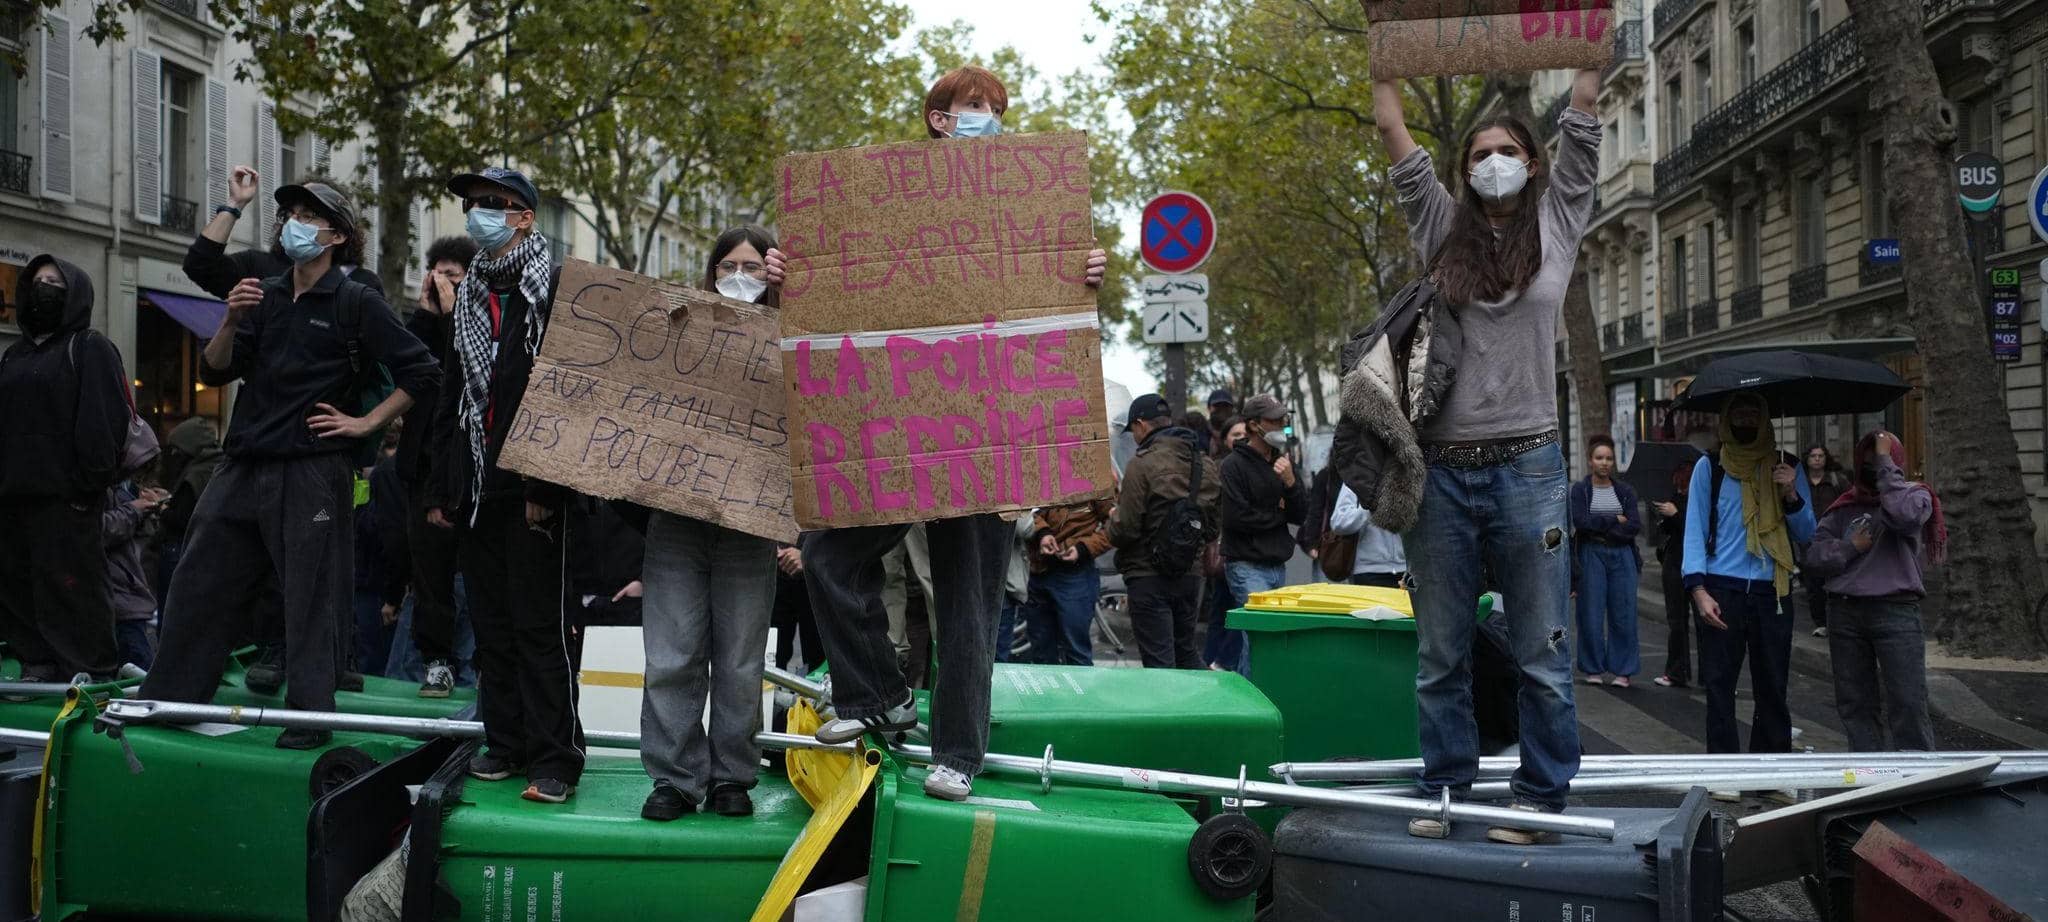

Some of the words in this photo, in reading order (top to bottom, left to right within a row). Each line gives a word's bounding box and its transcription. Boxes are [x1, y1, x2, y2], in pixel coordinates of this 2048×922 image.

[783, 158, 844, 213] LA
[864, 144, 1088, 204] JEUNESSE
[1960, 167, 1997, 186] BUS
[783, 208, 1088, 298] S'EXPRIME
[1874, 246, 1900, 257] Sain
[1996, 270, 2014, 283] 63
[1996, 302, 2016, 315] 87
[795, 335, 870, 399] LA
[885, 313, 1079, 397] POLICE
[508, 407, 570, 450] DES
[534, 367, 600, 401] AUX
[620, 386, 789, 448] FAMILLES
